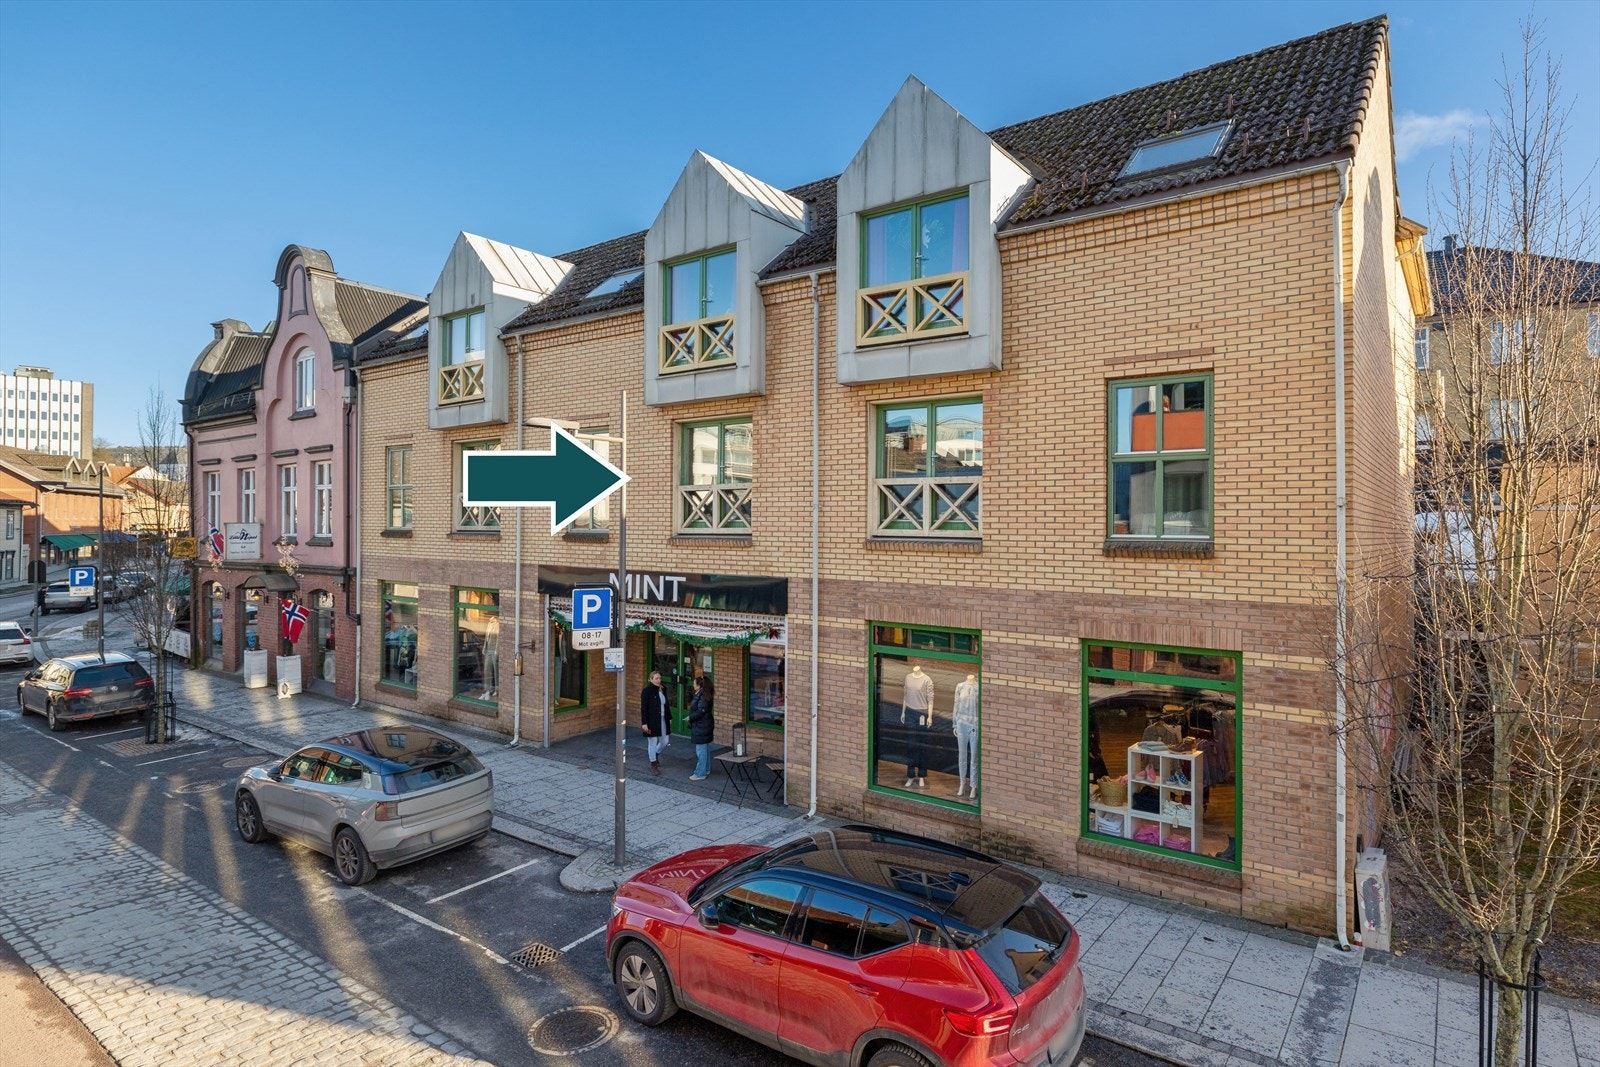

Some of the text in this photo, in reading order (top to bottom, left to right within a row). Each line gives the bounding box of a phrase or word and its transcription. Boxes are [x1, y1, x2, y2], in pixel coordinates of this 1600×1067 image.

[75, 570, 89, 585] P
[609, 572, 687, 602] MINT
[582, 594, 602, 624] P
[581, 631, 602, 639] 08-17
